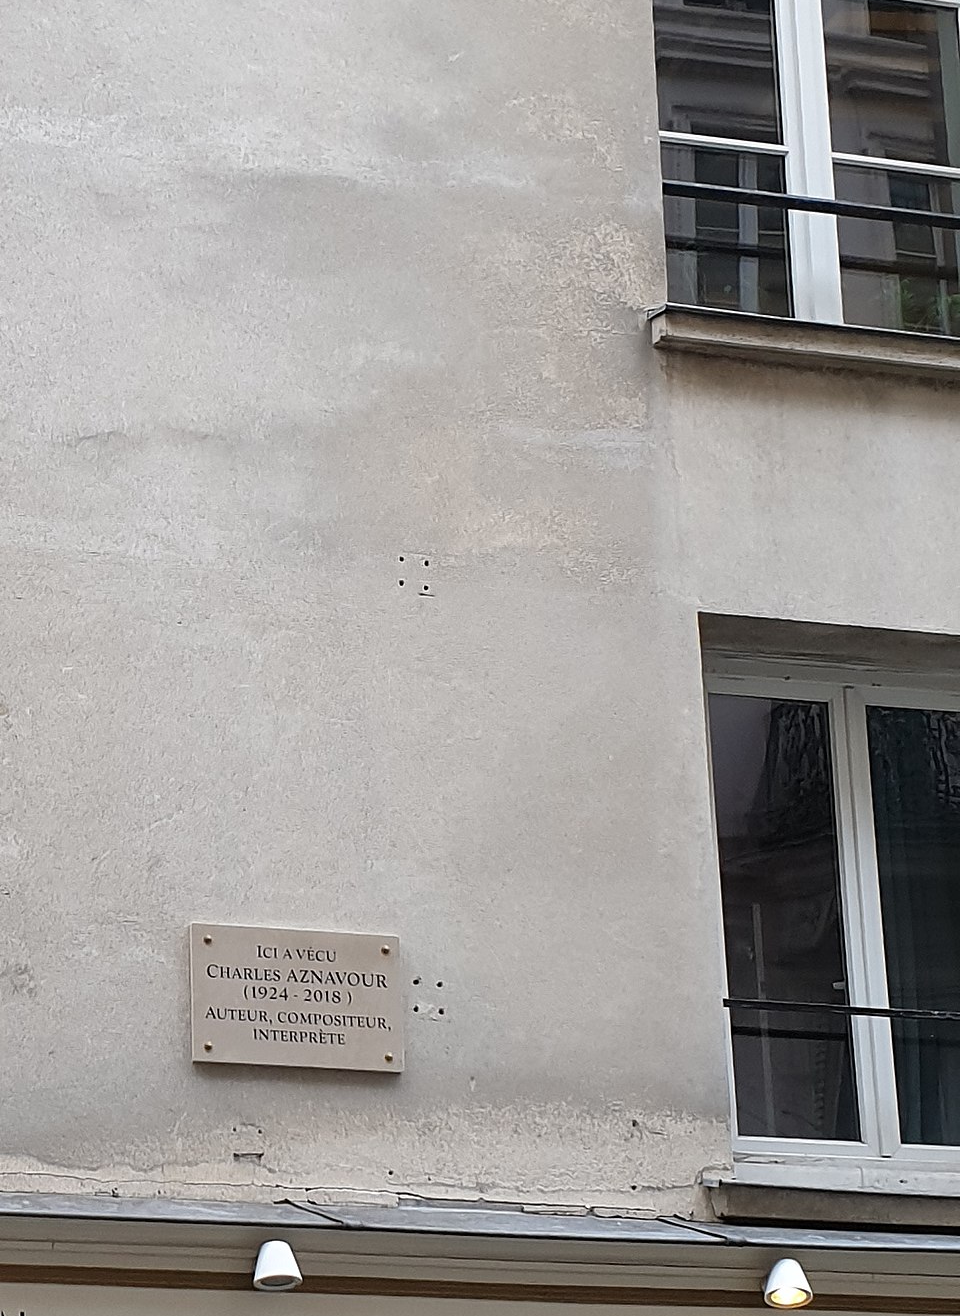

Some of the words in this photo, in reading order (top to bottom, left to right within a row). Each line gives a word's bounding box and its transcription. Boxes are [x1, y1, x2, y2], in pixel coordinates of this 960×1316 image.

[256, 944, 278, 959] ICI
[283, 948, 293, 960] A
[295, 946, 337, 963] VÉCU
[206, 963, 281, 982] CHARLES
[286, 968, 388, 989] AZNAVOUR
[205, 1006, 273, 1025] AUTEUR,
[277, 1011, 392, 1032] COMPOSITEUR,
[252, 1027, 346, 1046] INTERPRÈTE
